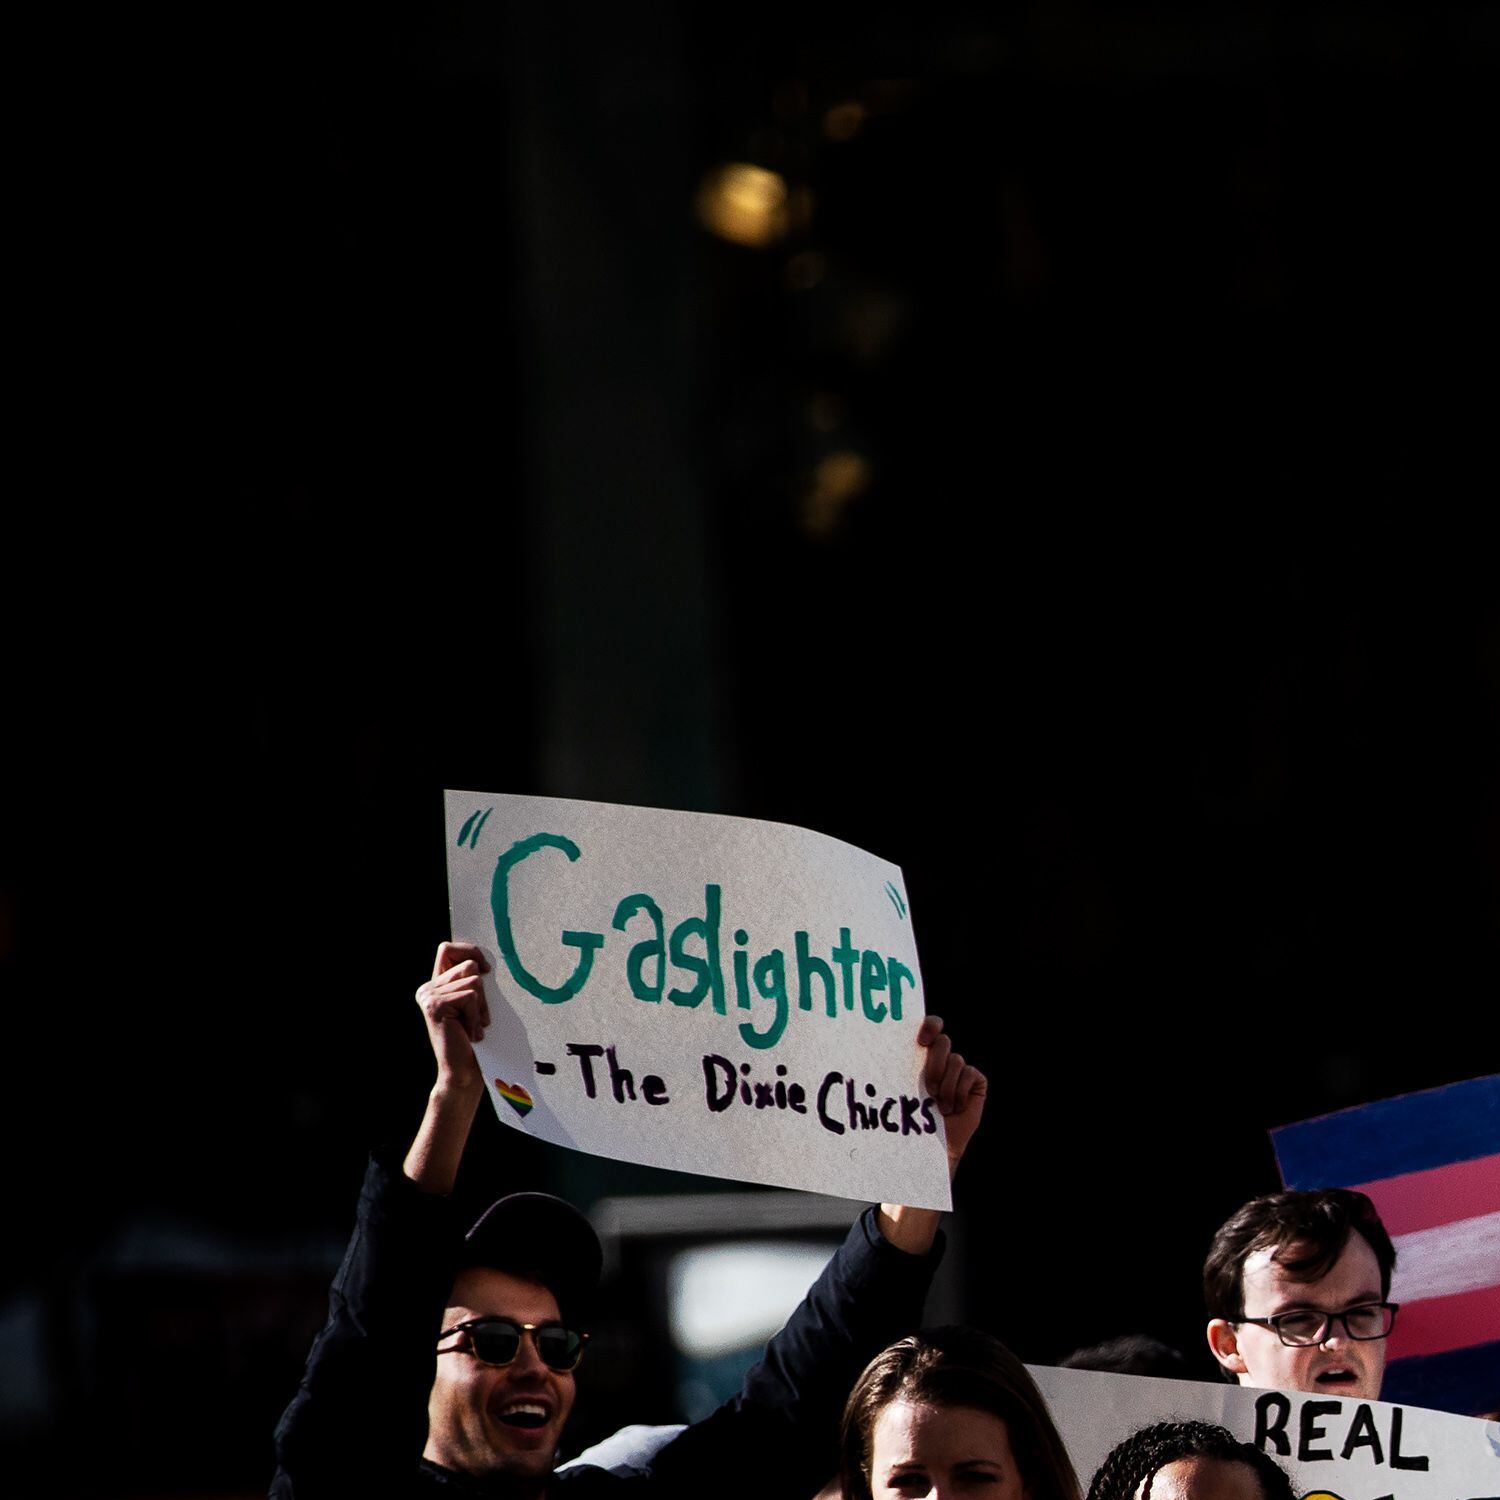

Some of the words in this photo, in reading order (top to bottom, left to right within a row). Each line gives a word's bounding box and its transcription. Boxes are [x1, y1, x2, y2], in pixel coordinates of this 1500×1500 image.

[702, 1053, 807, 1114] Dixie
[817, 1071, 937, 1136] Chicks
[1254, 1391, 1430, 1472] REAL
